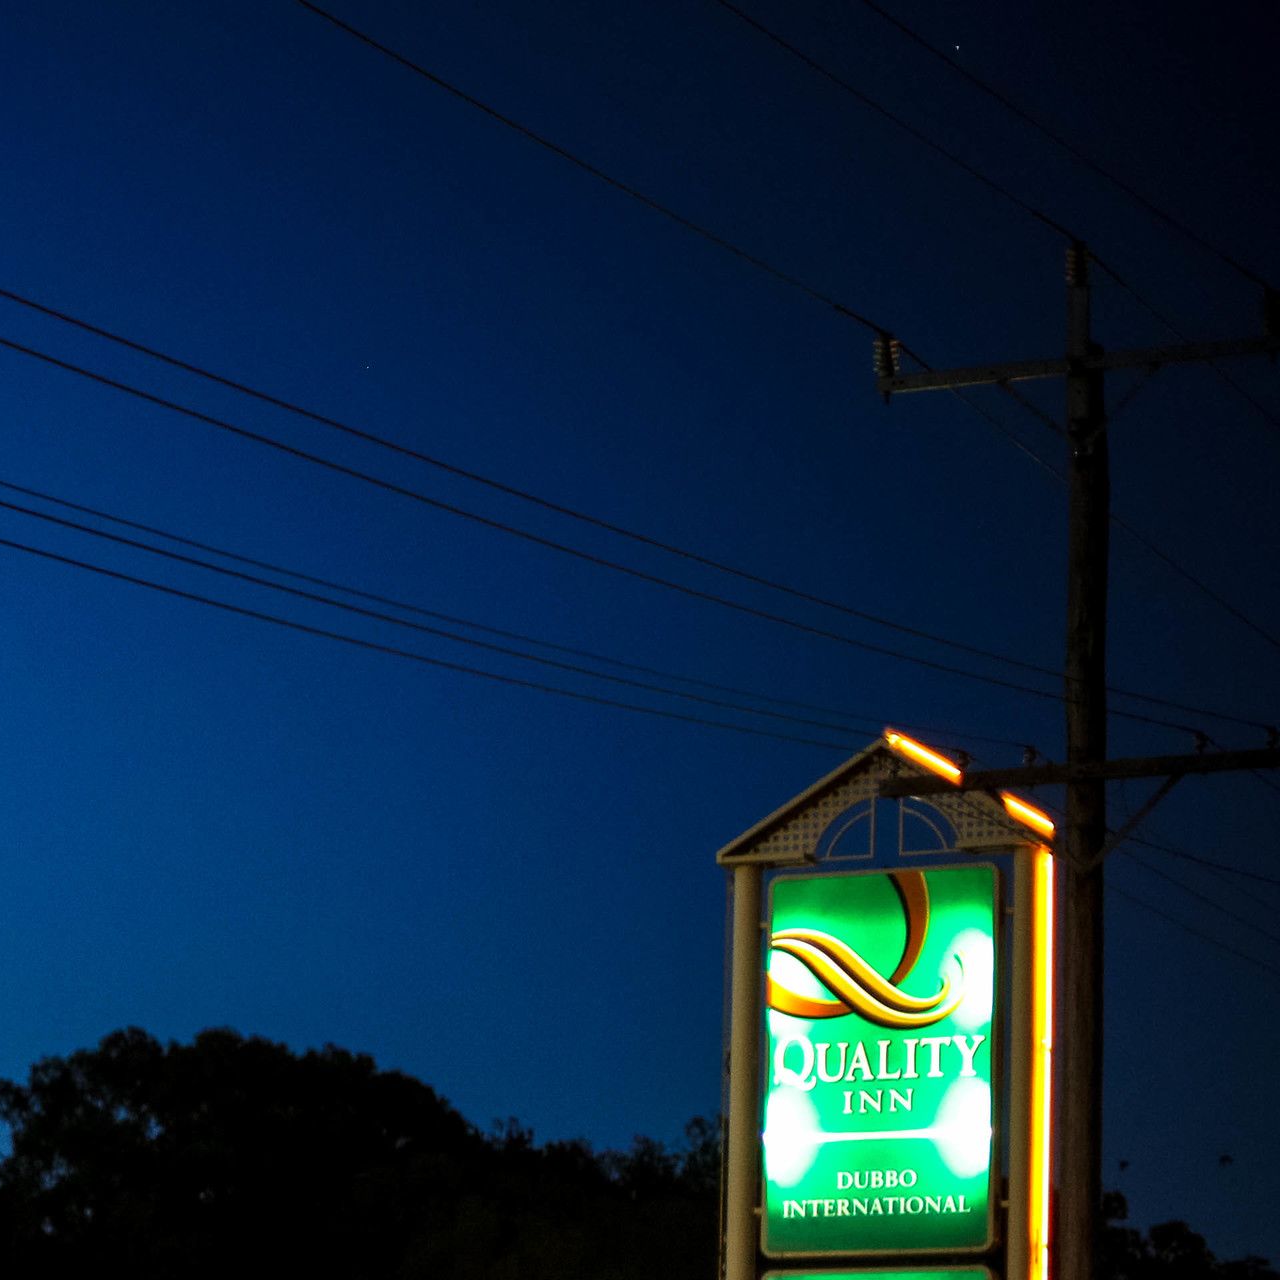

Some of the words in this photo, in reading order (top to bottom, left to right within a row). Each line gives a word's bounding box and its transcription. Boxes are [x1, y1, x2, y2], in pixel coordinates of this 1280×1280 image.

[773, 1034, 986, 1091] QUALITY
[842, 1088, 914, 1115] INN
[836, 1168, 918, 1191] DUBBO
[782, 1193, 972, 1220] INTERNATIONAL
